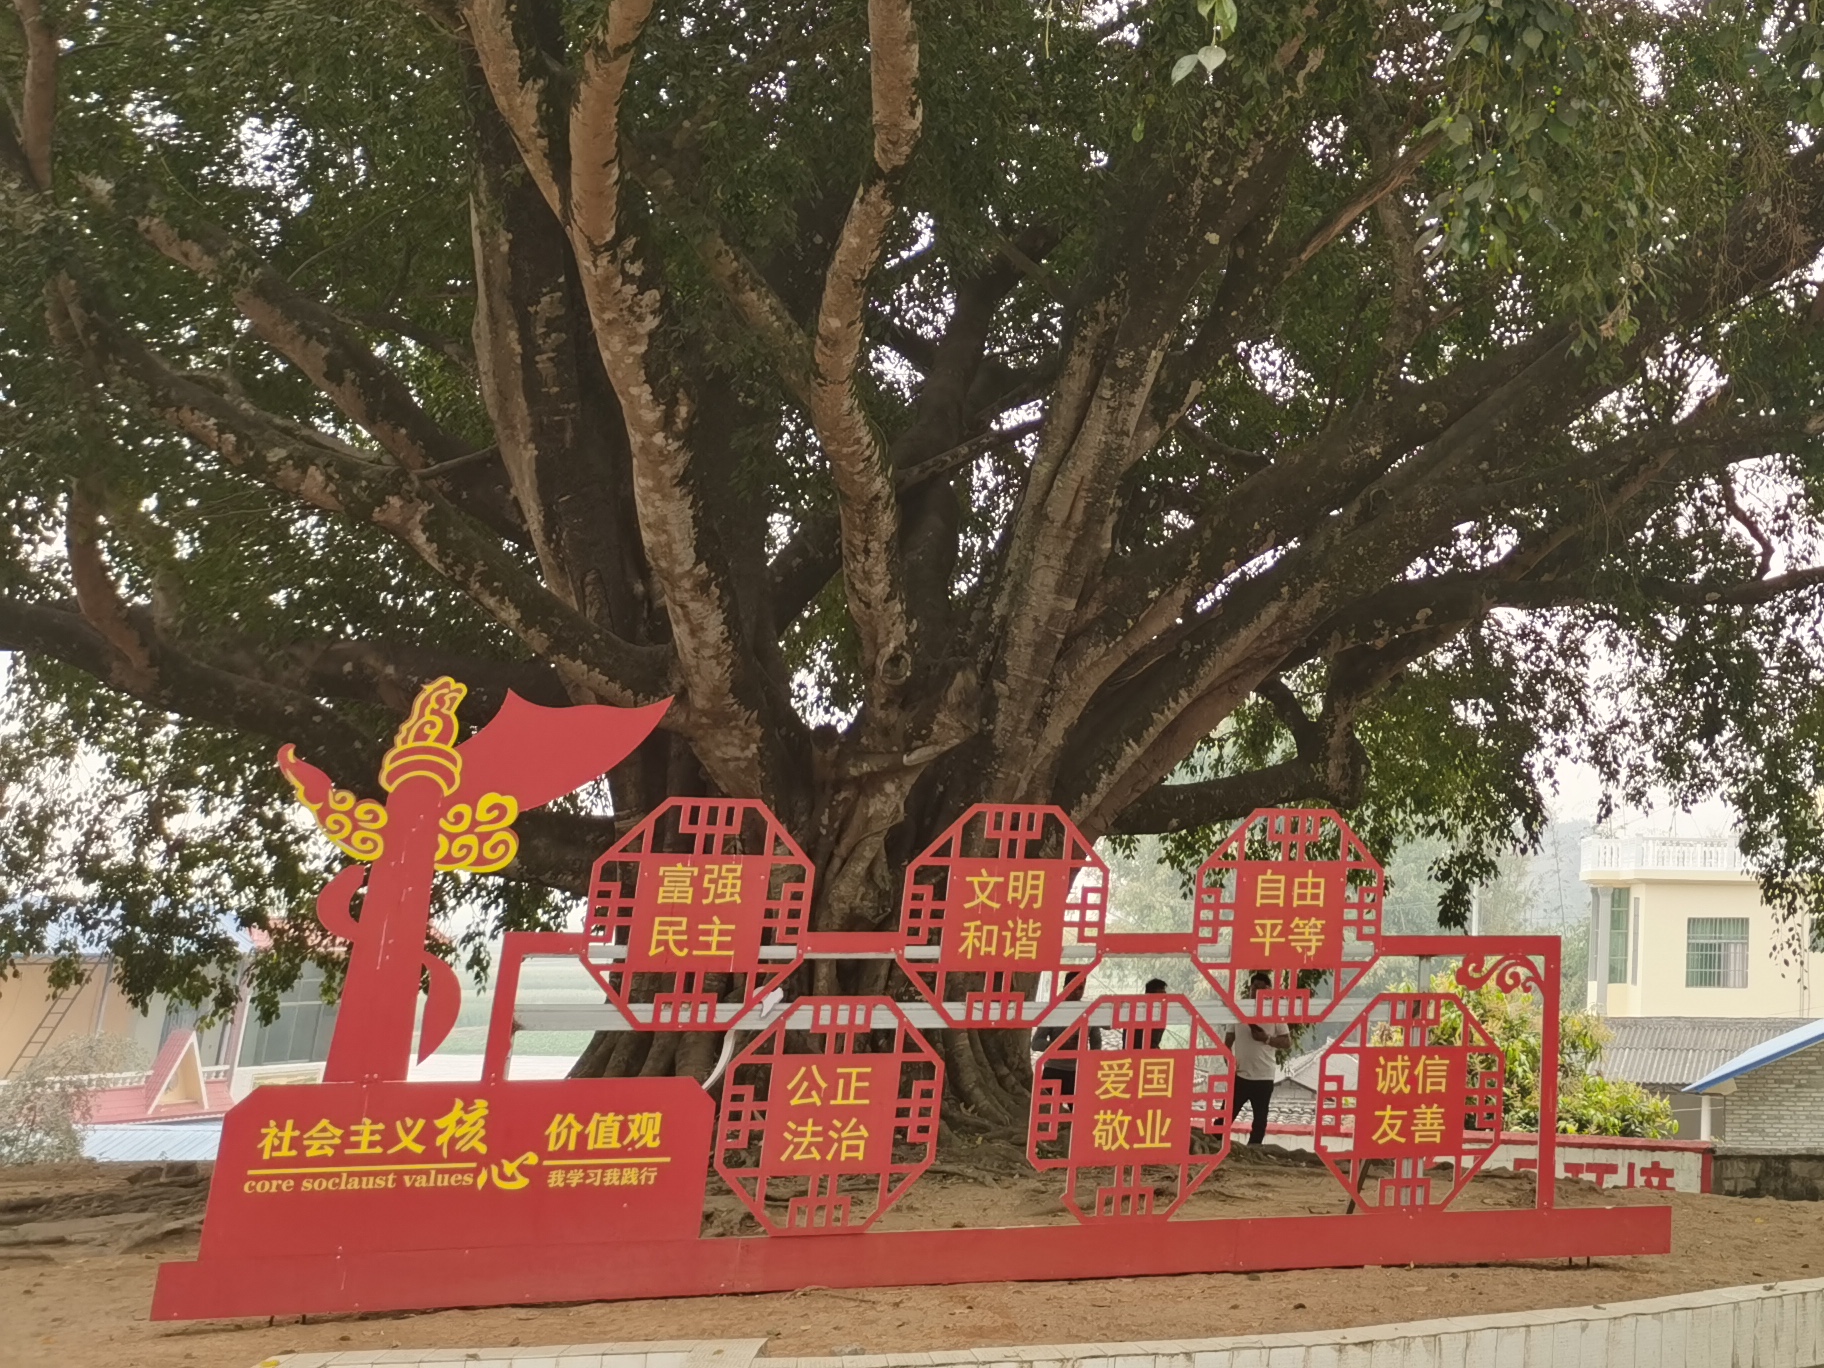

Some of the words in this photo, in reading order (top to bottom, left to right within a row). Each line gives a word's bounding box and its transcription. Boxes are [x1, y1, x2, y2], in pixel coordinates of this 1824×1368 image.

[657, 863, 744, 906] 富强
[963, 868, 1046, 911] 文明
[1256, 869, 1326, 909] 自由
[648, 915, 737, 959] 民主
[958, 919, 1042, 961] 和谐
[1250, 917, 1327, 958] 平等
[787, 1065, 873, 1108] 公正
[1095, 1058, 1175, 1101] 爱国
[1376, 1055, 1451, 1095] 诚信
[780, 1117, 870, 1163] 法治
[1092, 1109, 1173, 1152] 敬业
[1372, 1104, 1446, 1145] 友善
[244, 1179, 295, 1193] core
[403, 1170, 474, 1188] values
[547, 1167, 658, 1188] 我学习我践行
